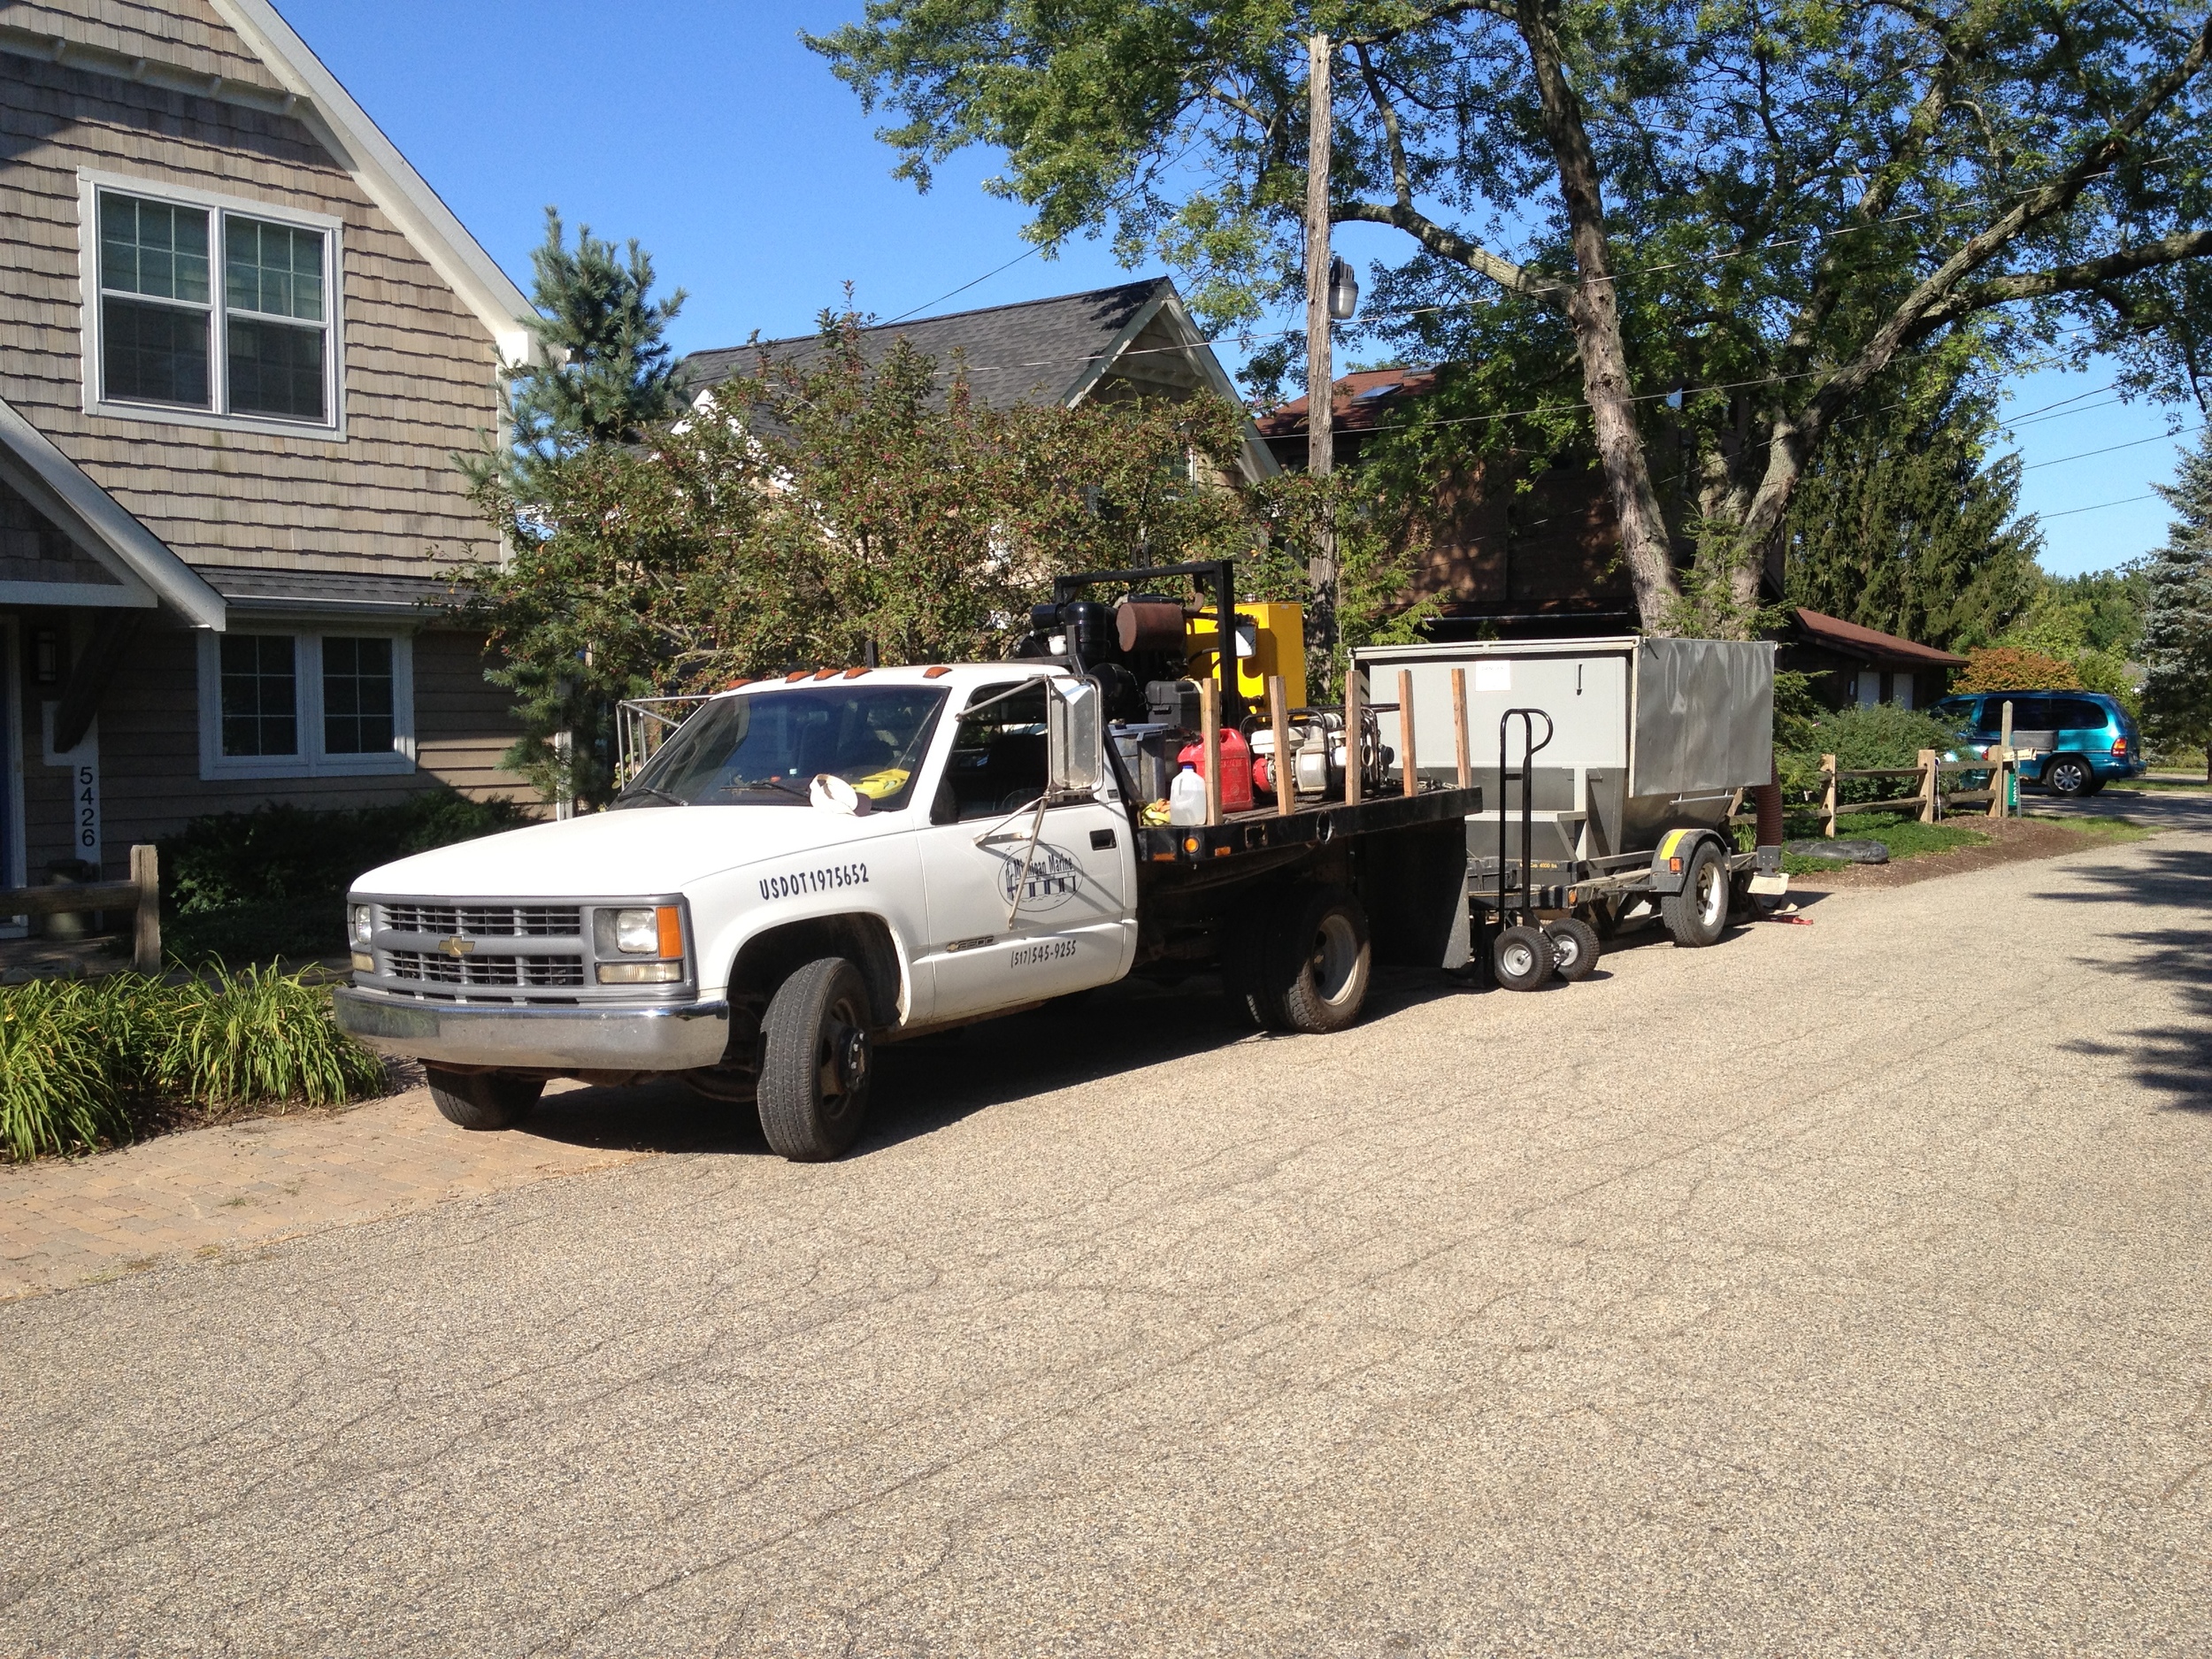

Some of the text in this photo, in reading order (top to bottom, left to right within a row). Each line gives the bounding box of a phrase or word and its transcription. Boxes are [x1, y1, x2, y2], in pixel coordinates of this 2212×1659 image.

[80, 766, 96, 847] 5426
[1013, 854, 1073, 877] Mihigan Marine
